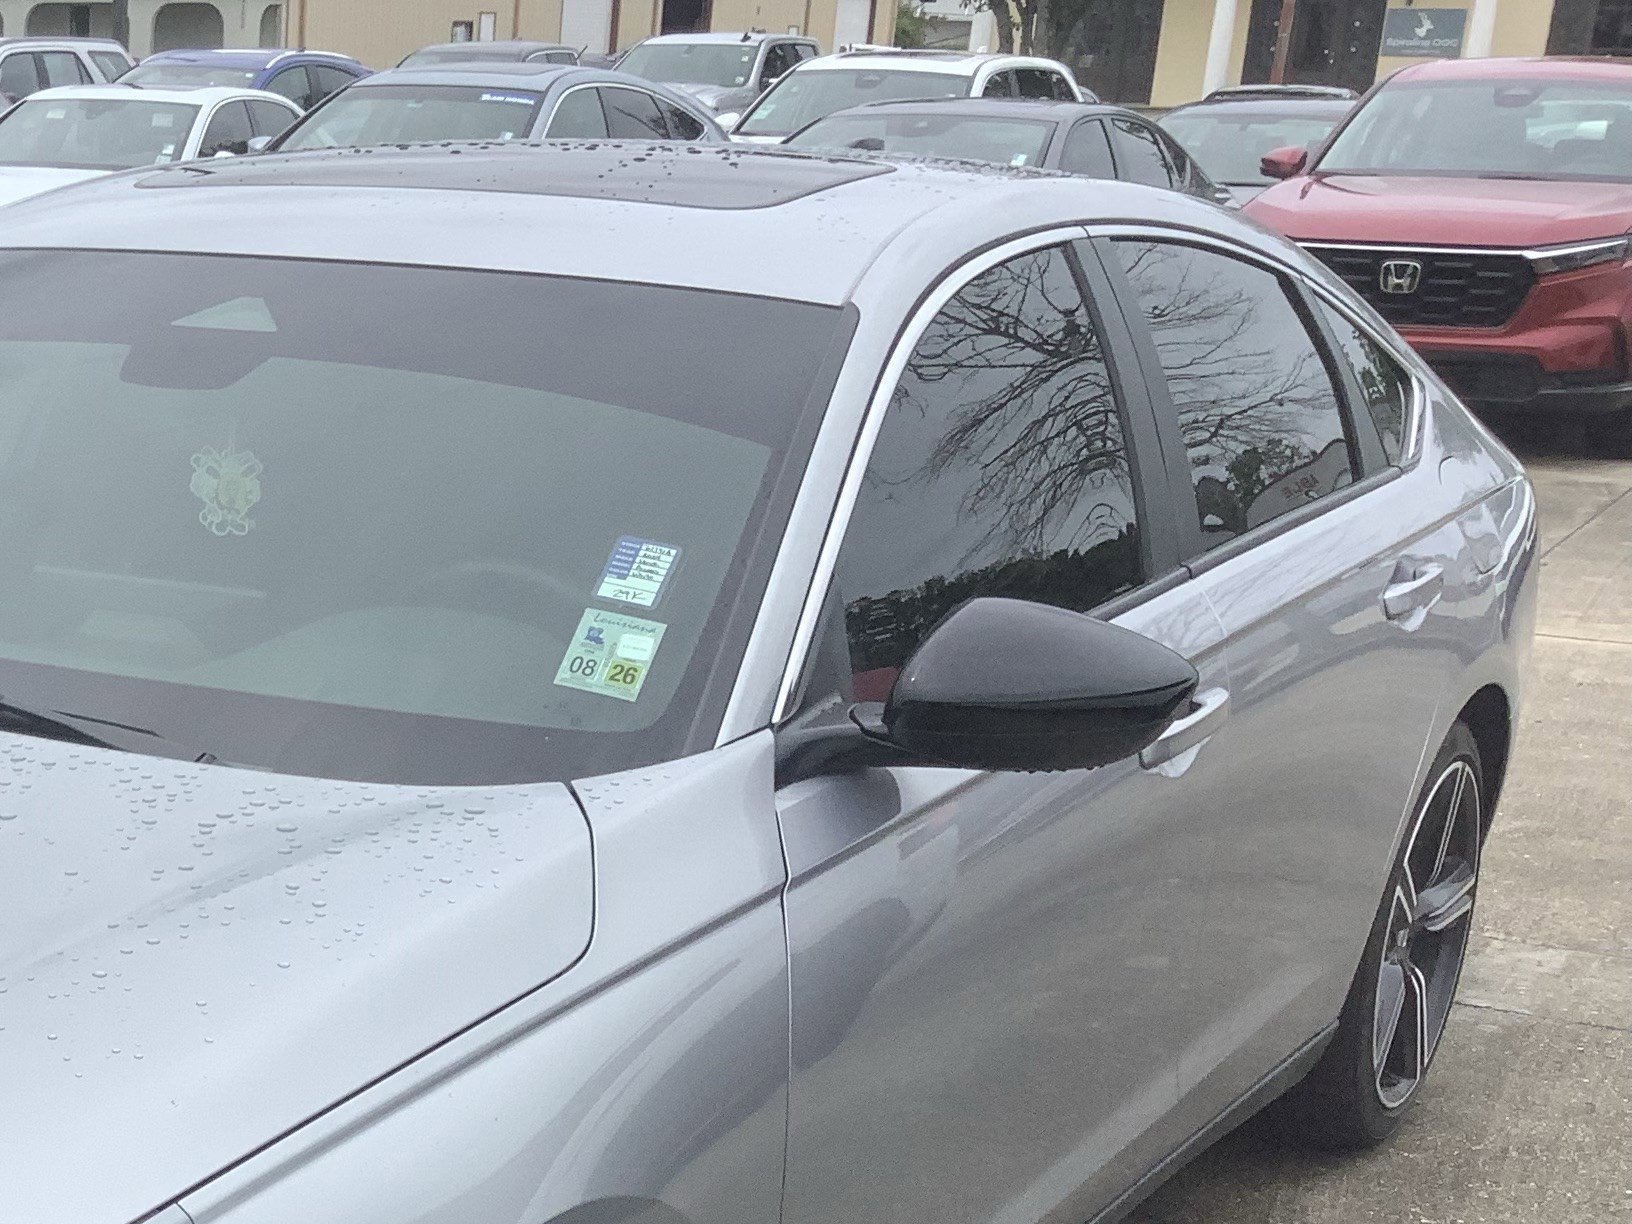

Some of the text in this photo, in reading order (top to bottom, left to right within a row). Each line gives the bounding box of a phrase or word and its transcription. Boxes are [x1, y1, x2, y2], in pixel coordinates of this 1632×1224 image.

[593, 612, 657, 634] Louisiana
[569, 655, 598, 677] 08
[608, 664, 638, 685] 26
